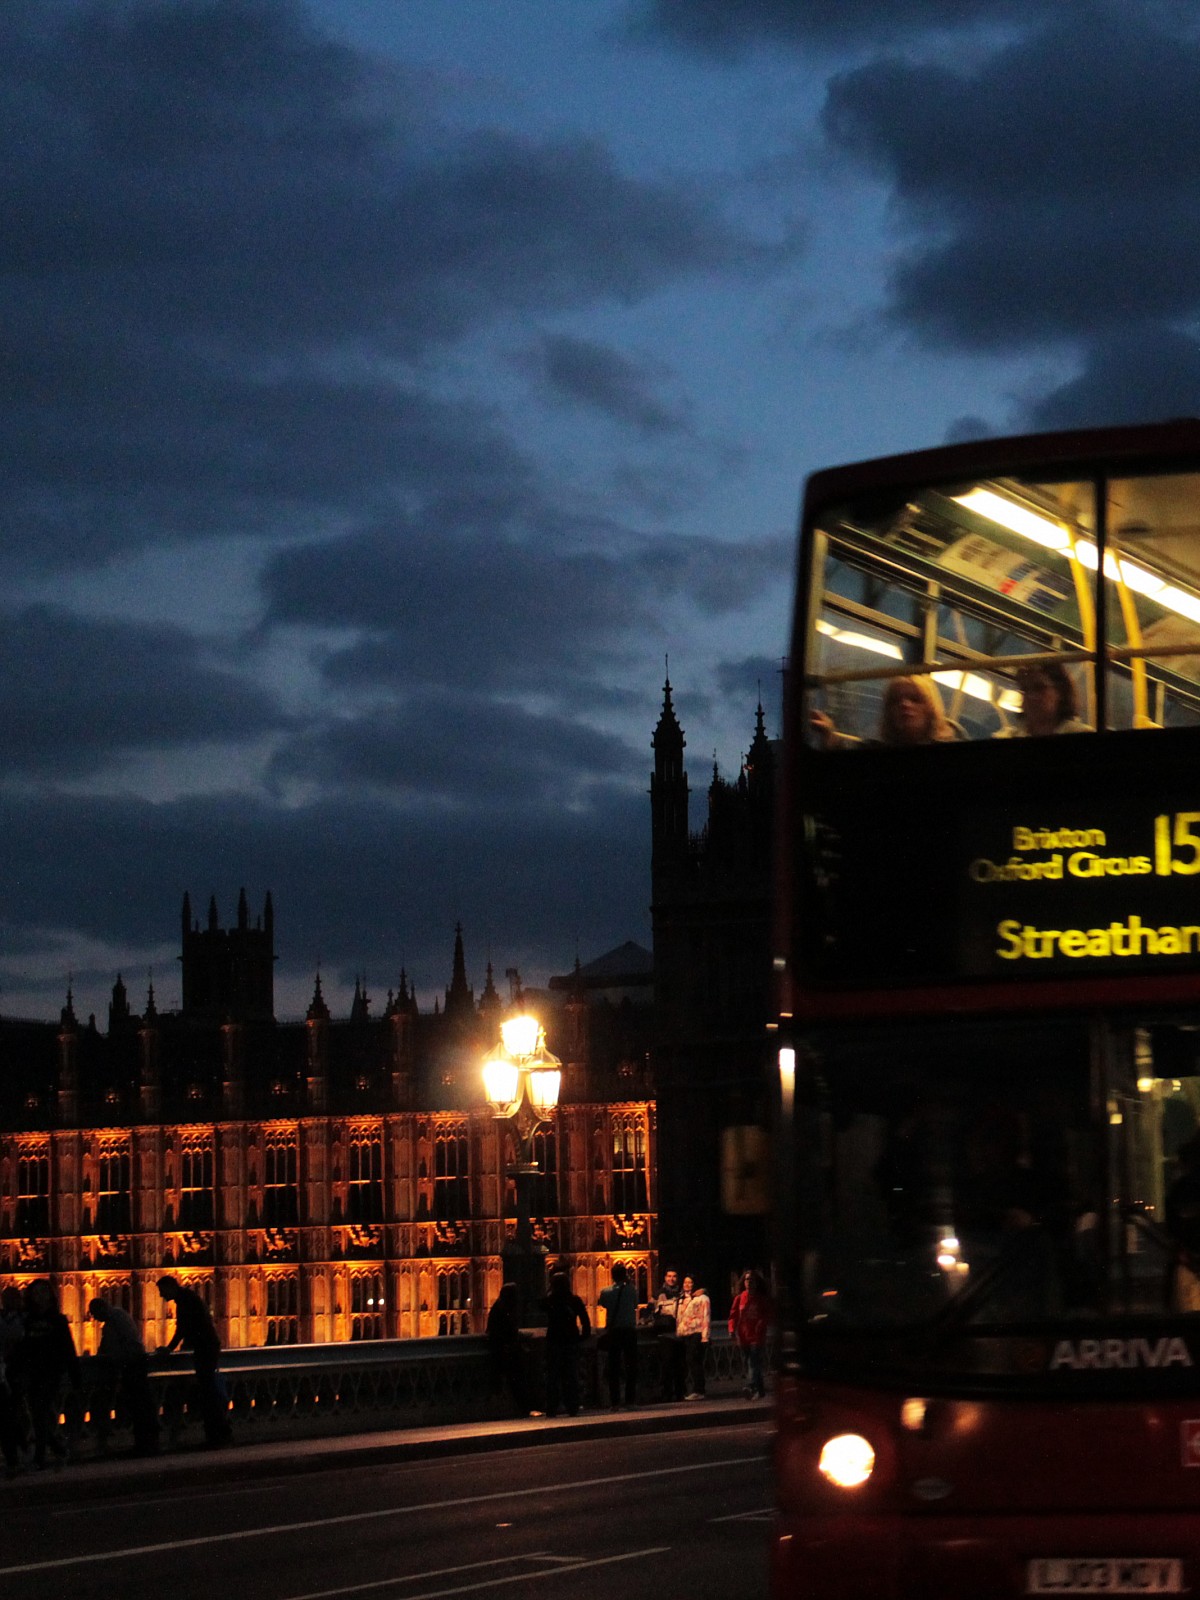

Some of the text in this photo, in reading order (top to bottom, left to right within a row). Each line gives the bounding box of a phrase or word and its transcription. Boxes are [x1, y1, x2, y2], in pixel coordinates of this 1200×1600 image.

[1012, 826, 1107, 851] Brixton
[968, 851, 1152, 883] Oxford Circus
[1048, 1336, 1195, 1371] ARRIVA
